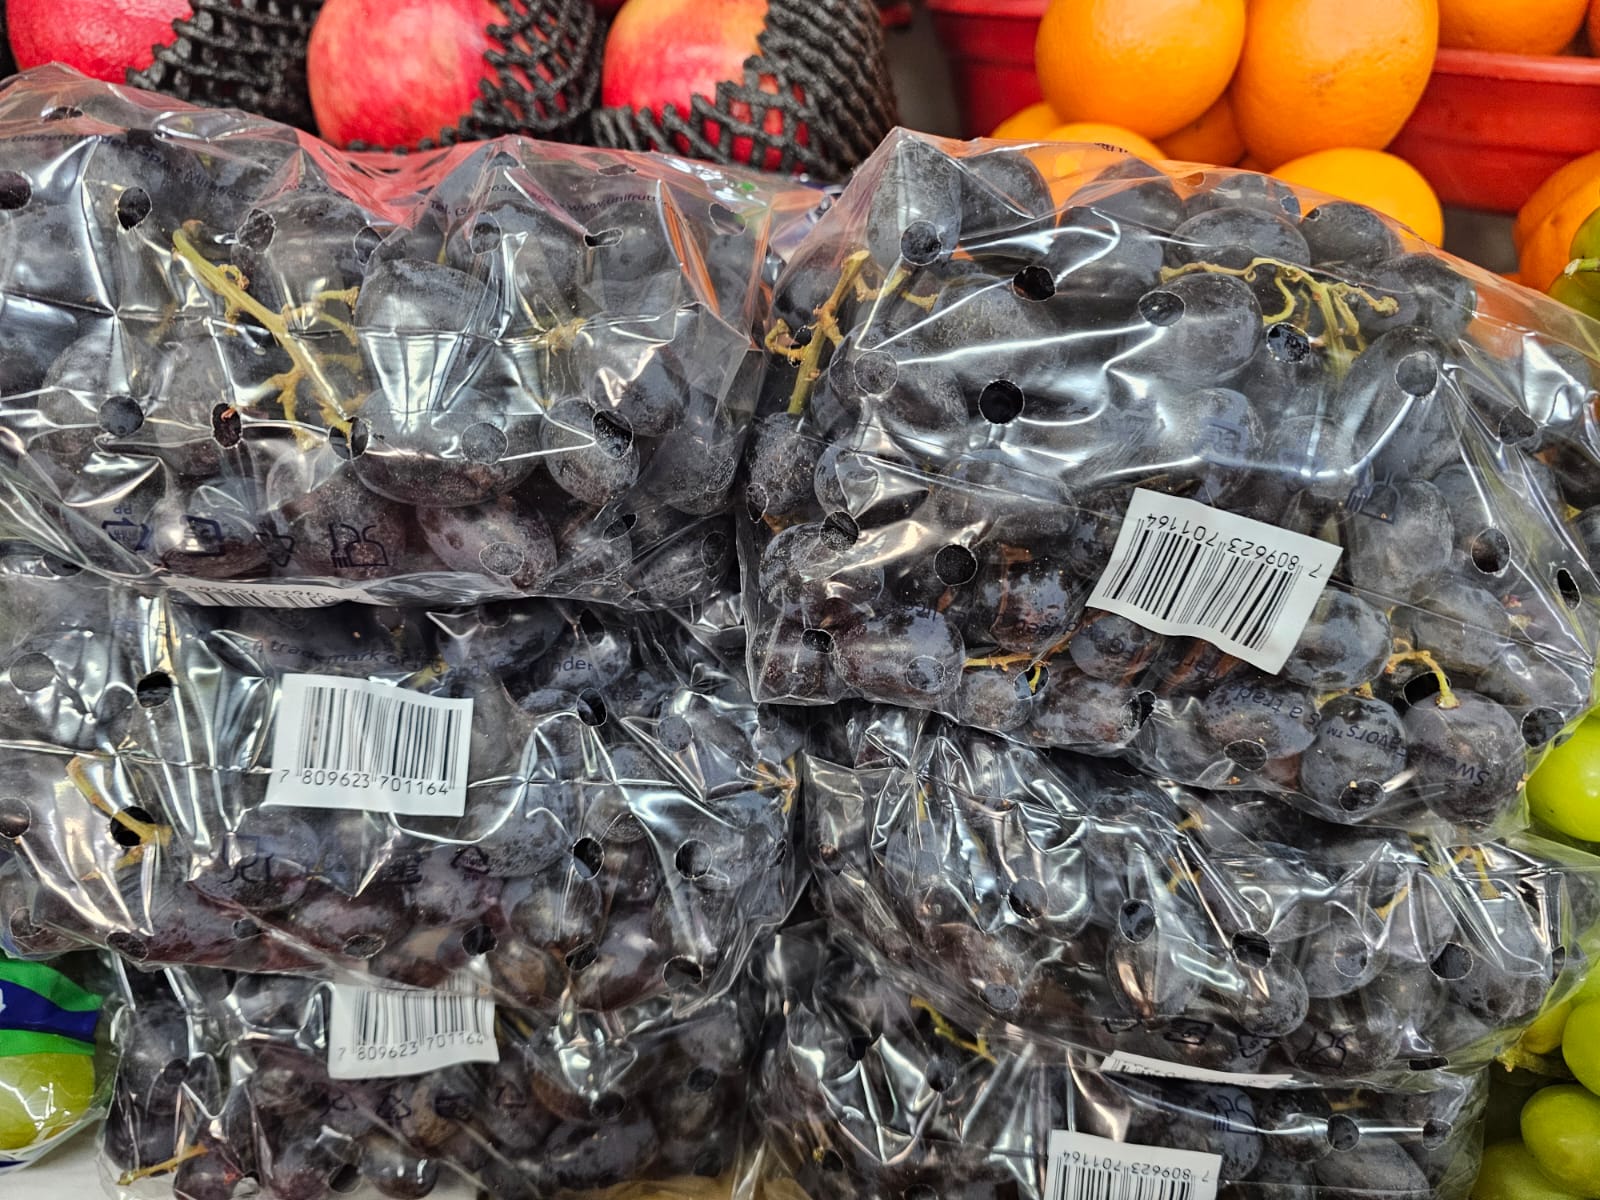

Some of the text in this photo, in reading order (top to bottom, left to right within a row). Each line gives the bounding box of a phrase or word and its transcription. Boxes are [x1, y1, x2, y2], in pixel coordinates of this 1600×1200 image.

[568, 192, 659, 212] www.unifrutt
[1147, 513, 1322, 578] 7 809623 701164
[546, 656, 593, 671] nder
[1289, 706, 1303, 719] a
[279, 769, 449, 795] 7 809623 701164
[338, 1032, 484, 1060] 7 809623 701164
[1063, 1150, 1210, 1183] 7 809623 701164
